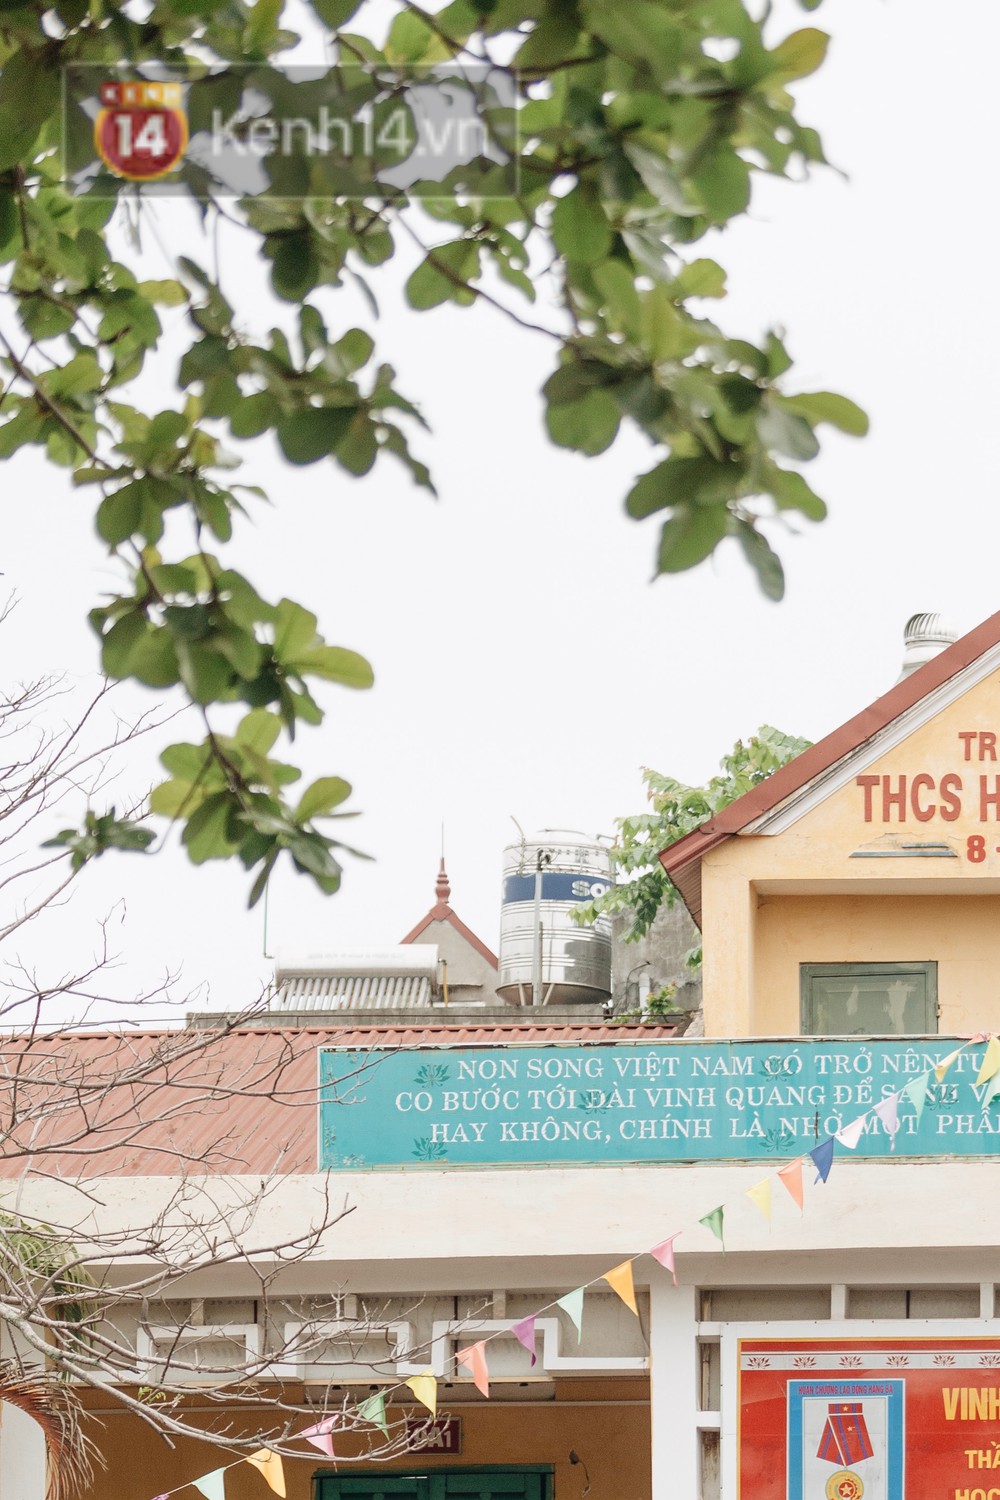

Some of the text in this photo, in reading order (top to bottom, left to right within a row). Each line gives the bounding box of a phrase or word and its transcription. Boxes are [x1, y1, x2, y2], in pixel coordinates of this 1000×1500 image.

[856, 773, 963, 822] THCS
[457, 1059, 519, 1080] NON
[527, 1057, 604, 1079] SONG
[613, 1052, 680, 1082] VIỆT
[691, 1056, 754, 1076] NAM
[765, 1048, 803, 1075] CÓ
[815, 1047, 872, 1075] TRỞ
[881, 1048, 943, 1073] NÊN
[441, 1083, 519, 1111] BƯỚC
[528, 1083, 577, 1110] TỚI
[586, 1081, 636, 1108] ĐÀI
[644, 1087, 716, 1108] VINH
[725, 1085, 826, 1111] QUANG
[833, 1076, 873, 1105] ĐỂ
[430, 1122, 488, 1143] HAY
[500, 1116, 611, 1144] KHÔNG,
[619, 1114, 712, 1139] CHÍNH
[729, 1111, 766, 1138] LÀ
[779, 1108, 842, 1137] NHỜ
